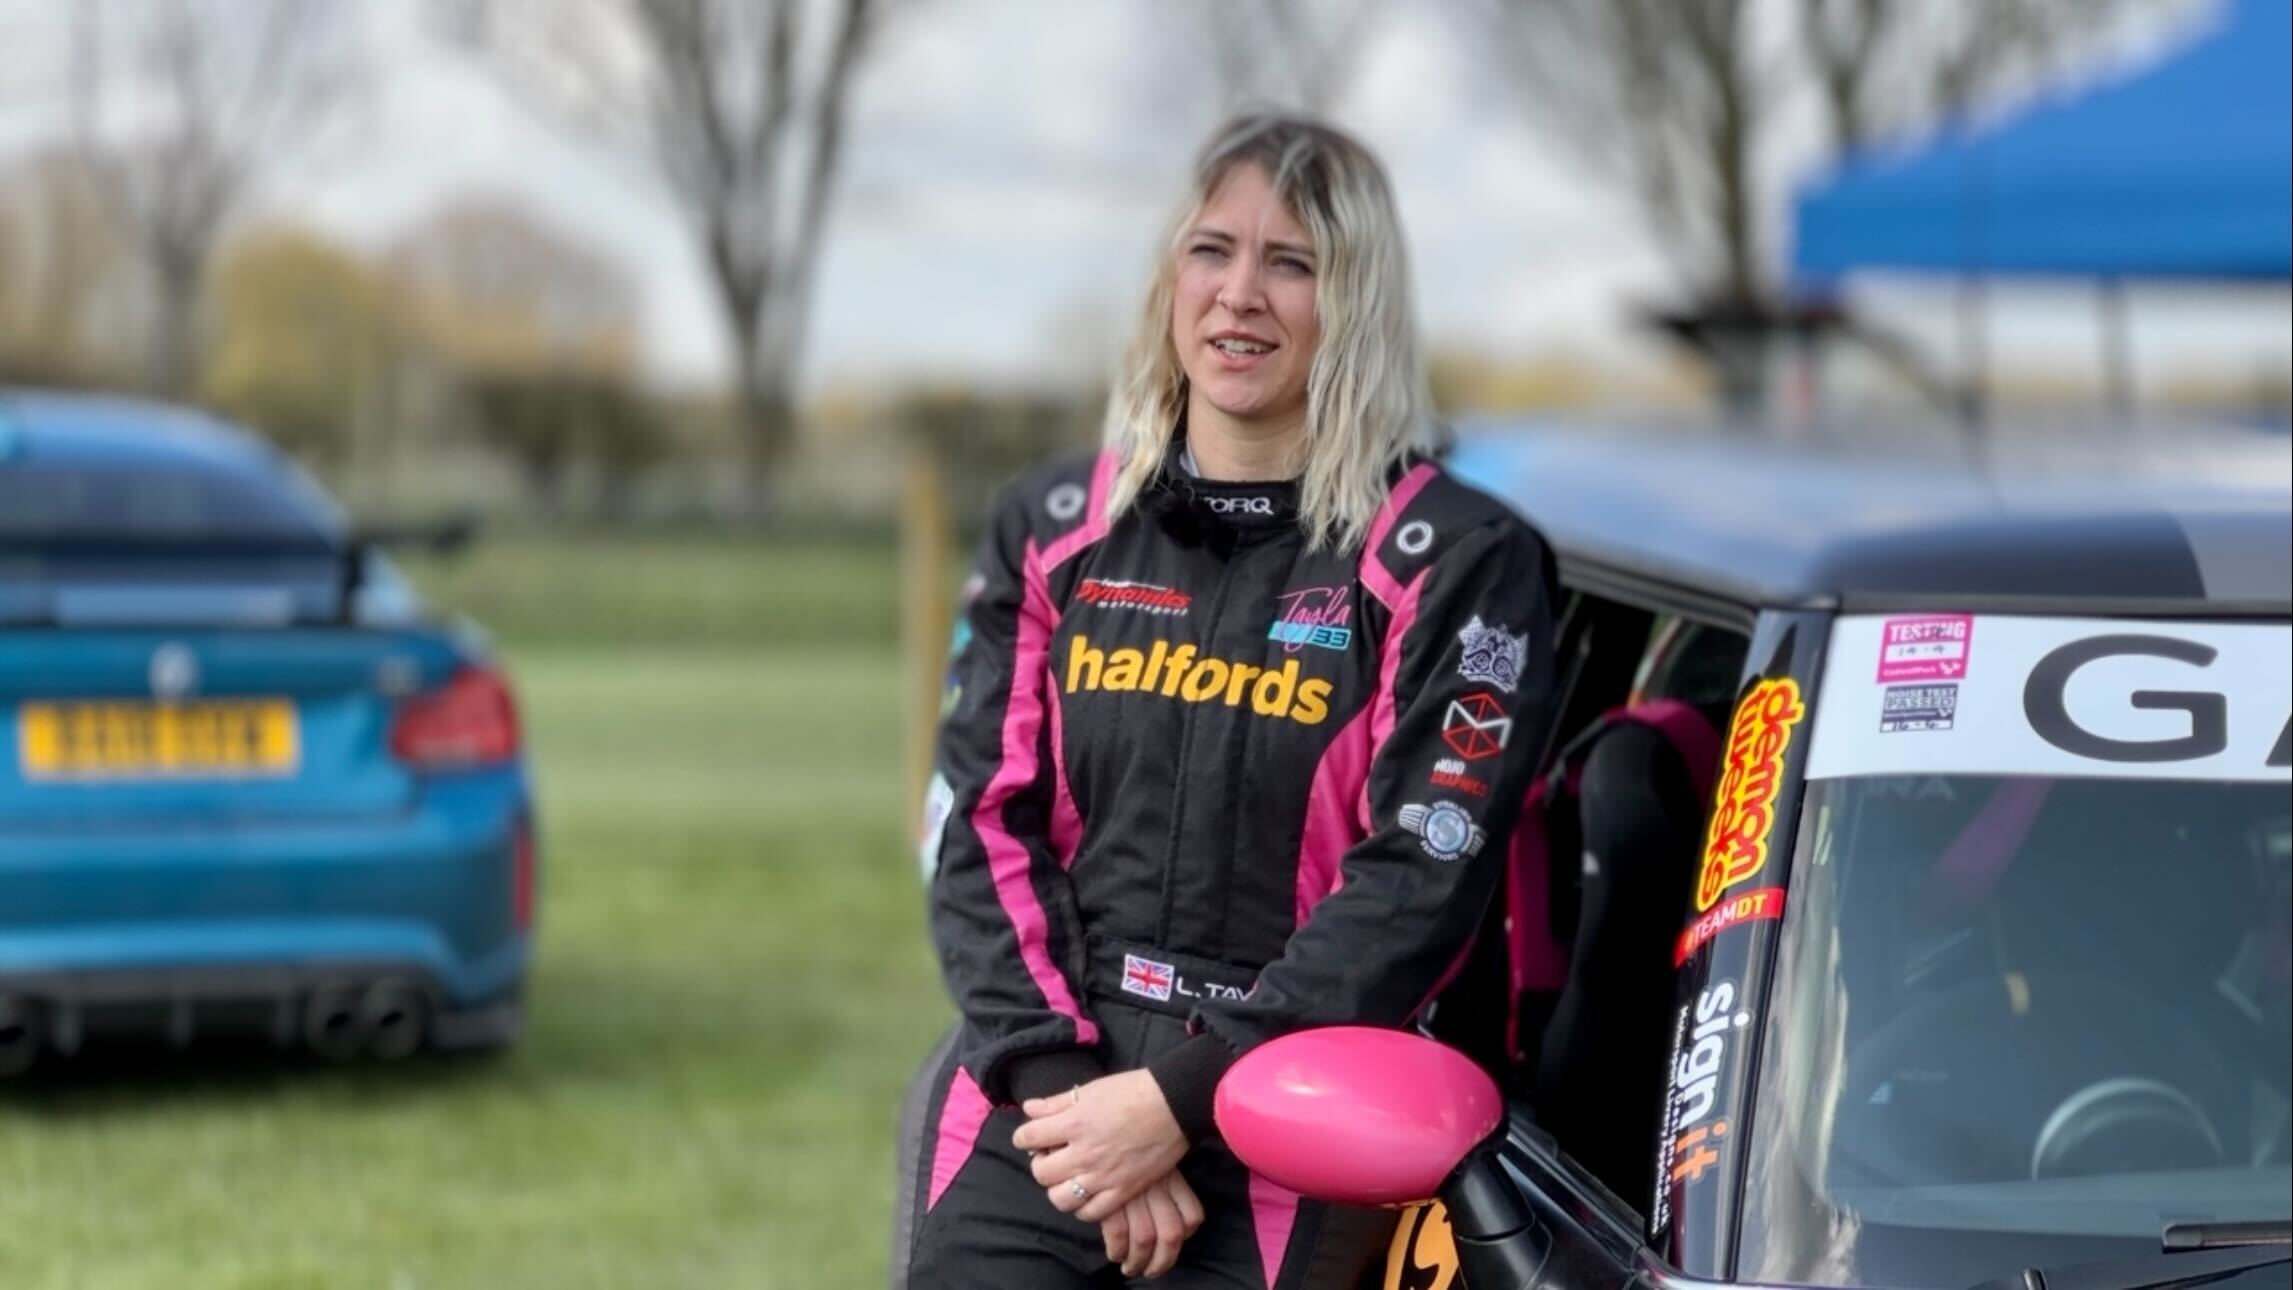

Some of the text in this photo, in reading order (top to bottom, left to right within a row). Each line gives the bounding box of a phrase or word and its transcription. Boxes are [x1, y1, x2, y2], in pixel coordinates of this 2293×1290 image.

[1203, 496, 1275, 515] ORQ
[1065, 634, 1334, 725] halfords
[1885, 697, 1954, 710] PASSED
[2022, 633, 2292, 767] G
[1698, 685, 1767, 907] tweeks
[1727, 681, 1801, 883] demon
